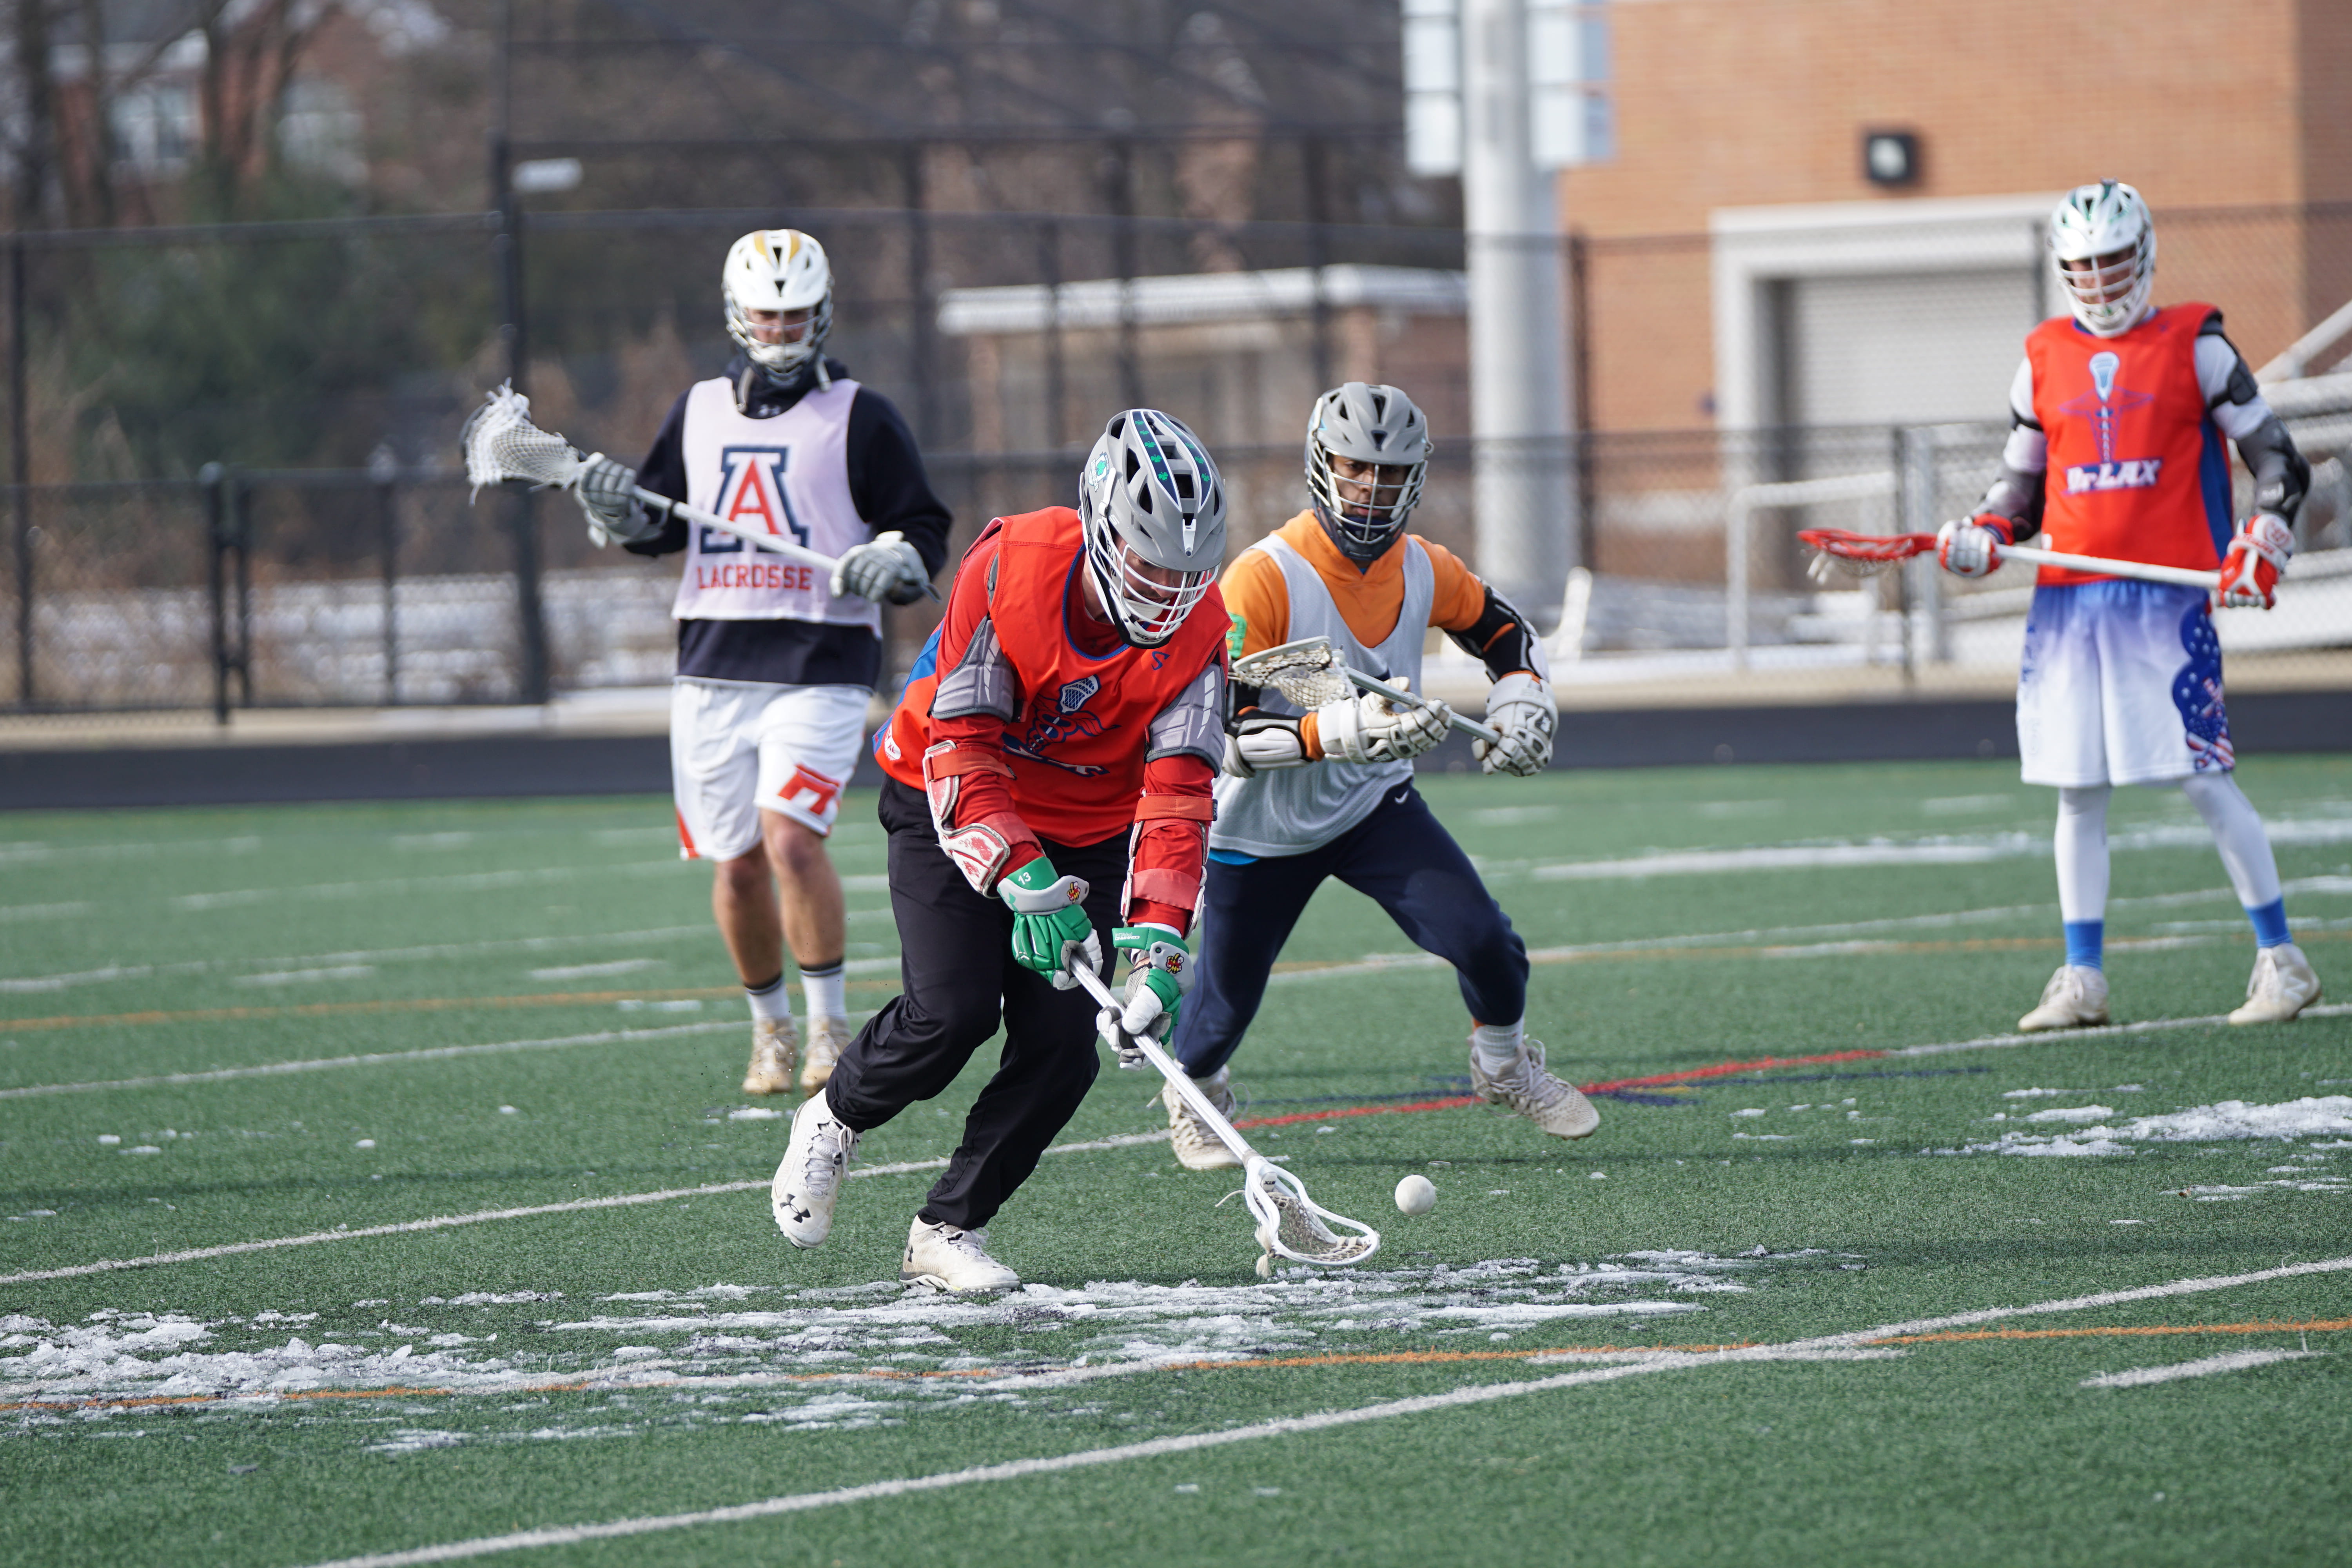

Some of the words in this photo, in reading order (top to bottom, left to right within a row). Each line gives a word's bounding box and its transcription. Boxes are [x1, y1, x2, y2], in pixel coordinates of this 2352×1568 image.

[701, 447, 809, 554] A
[697, 565, 813, 590] LACROSSE
[887, 742, 895, 753] XL
[1018, 872, 1031, 885] 13
